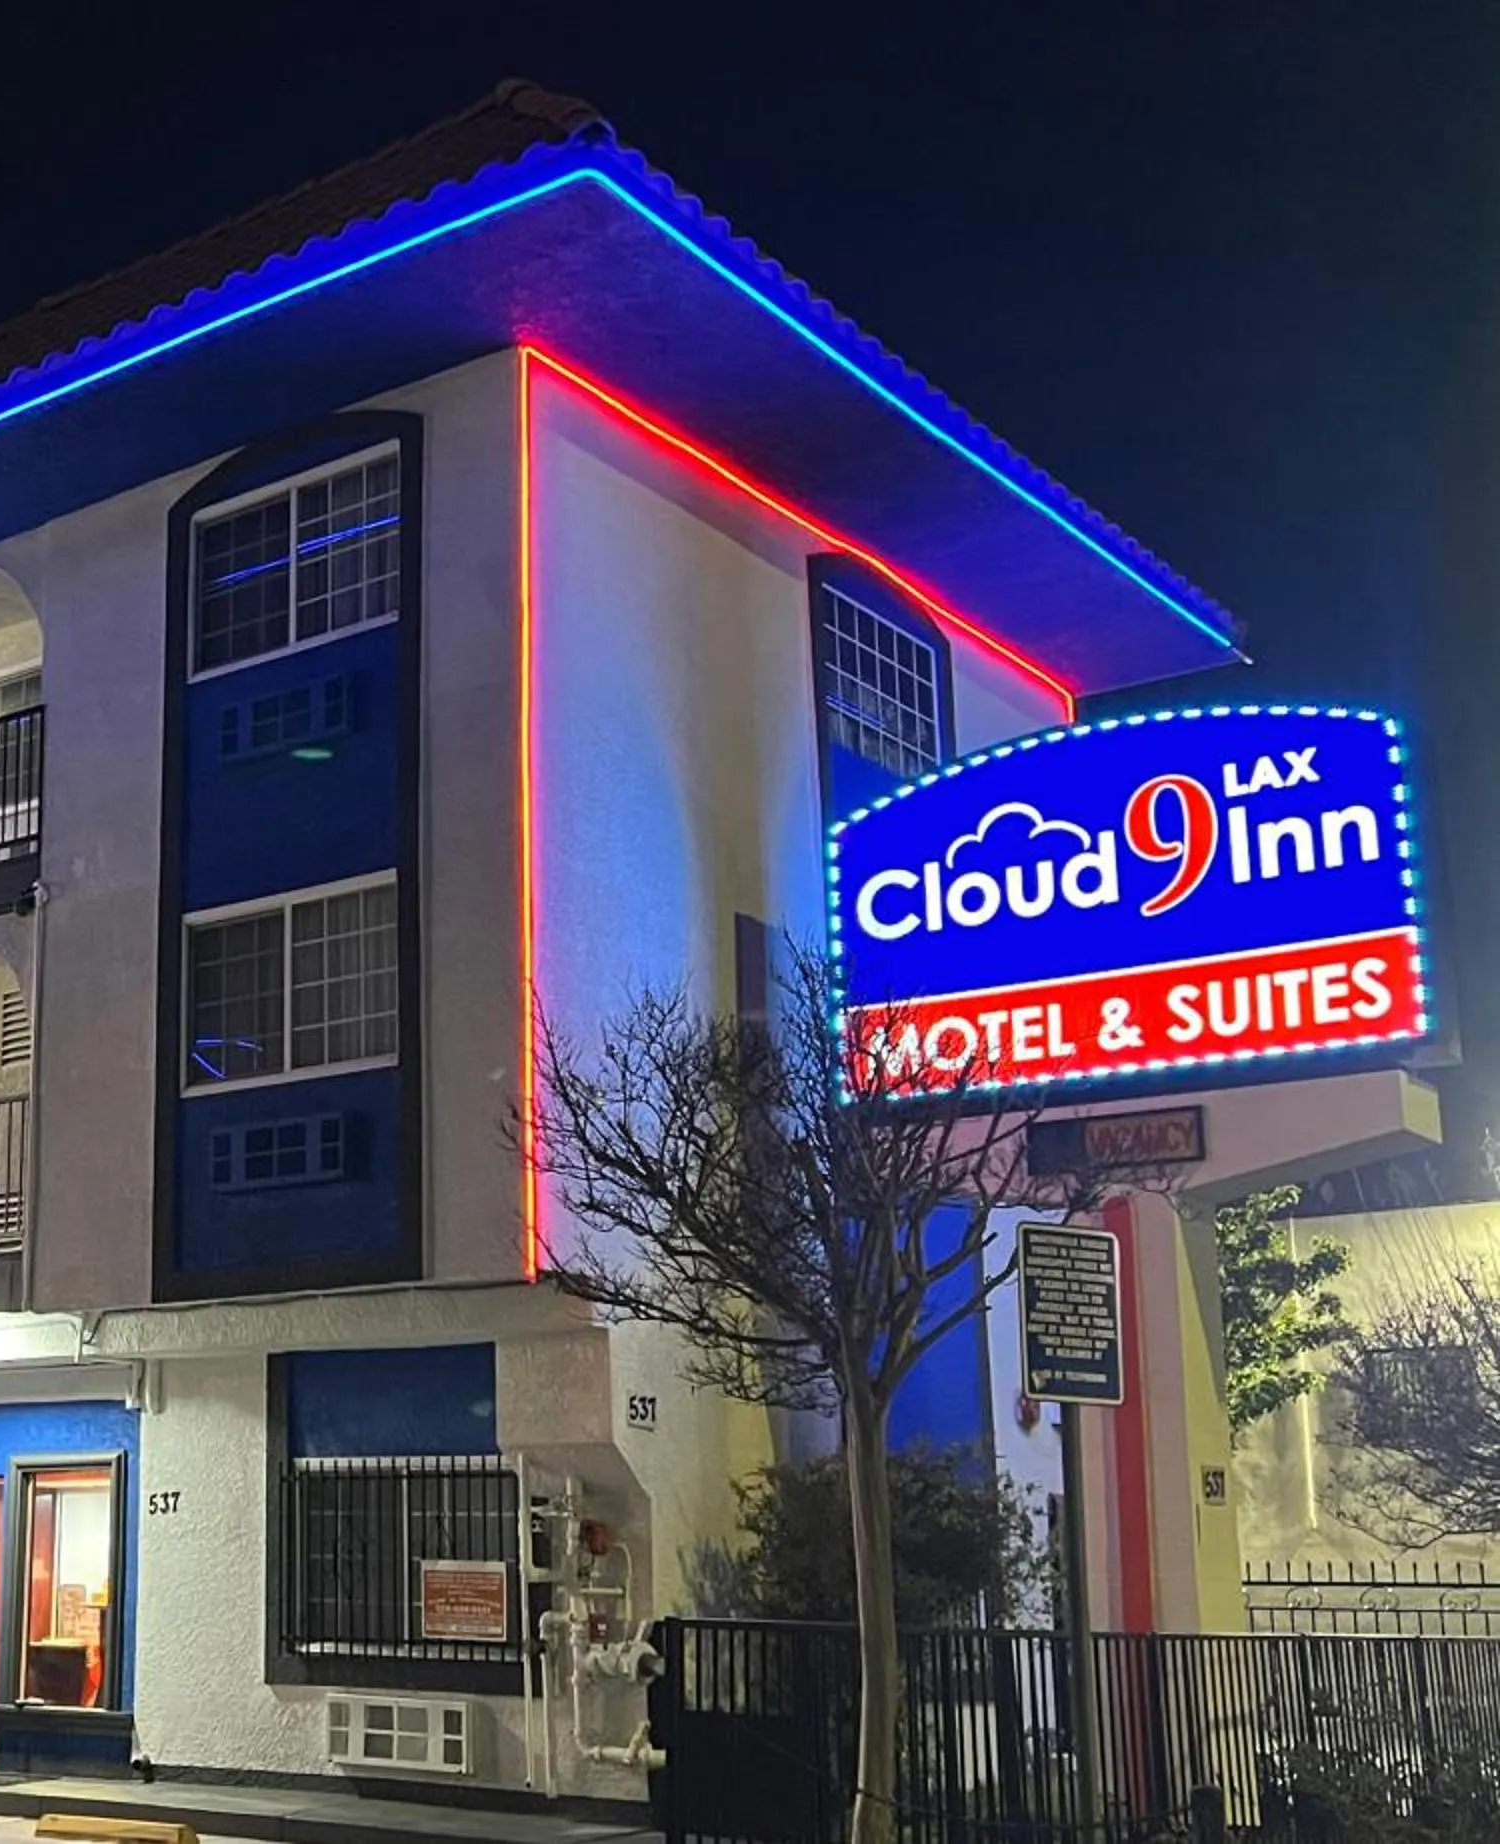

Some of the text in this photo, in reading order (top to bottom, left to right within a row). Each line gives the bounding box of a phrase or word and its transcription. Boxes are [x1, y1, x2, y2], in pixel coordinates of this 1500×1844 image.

[1223, 747, 1320, 799] LAX
[856, 774, 1381, 941] Cloud 9 Inn
[866, 957, 1392, 1081] MOTEL & SUITES
[629, 1394, 657, 1422] 537
[149, 1491, 181, 1515] 537
